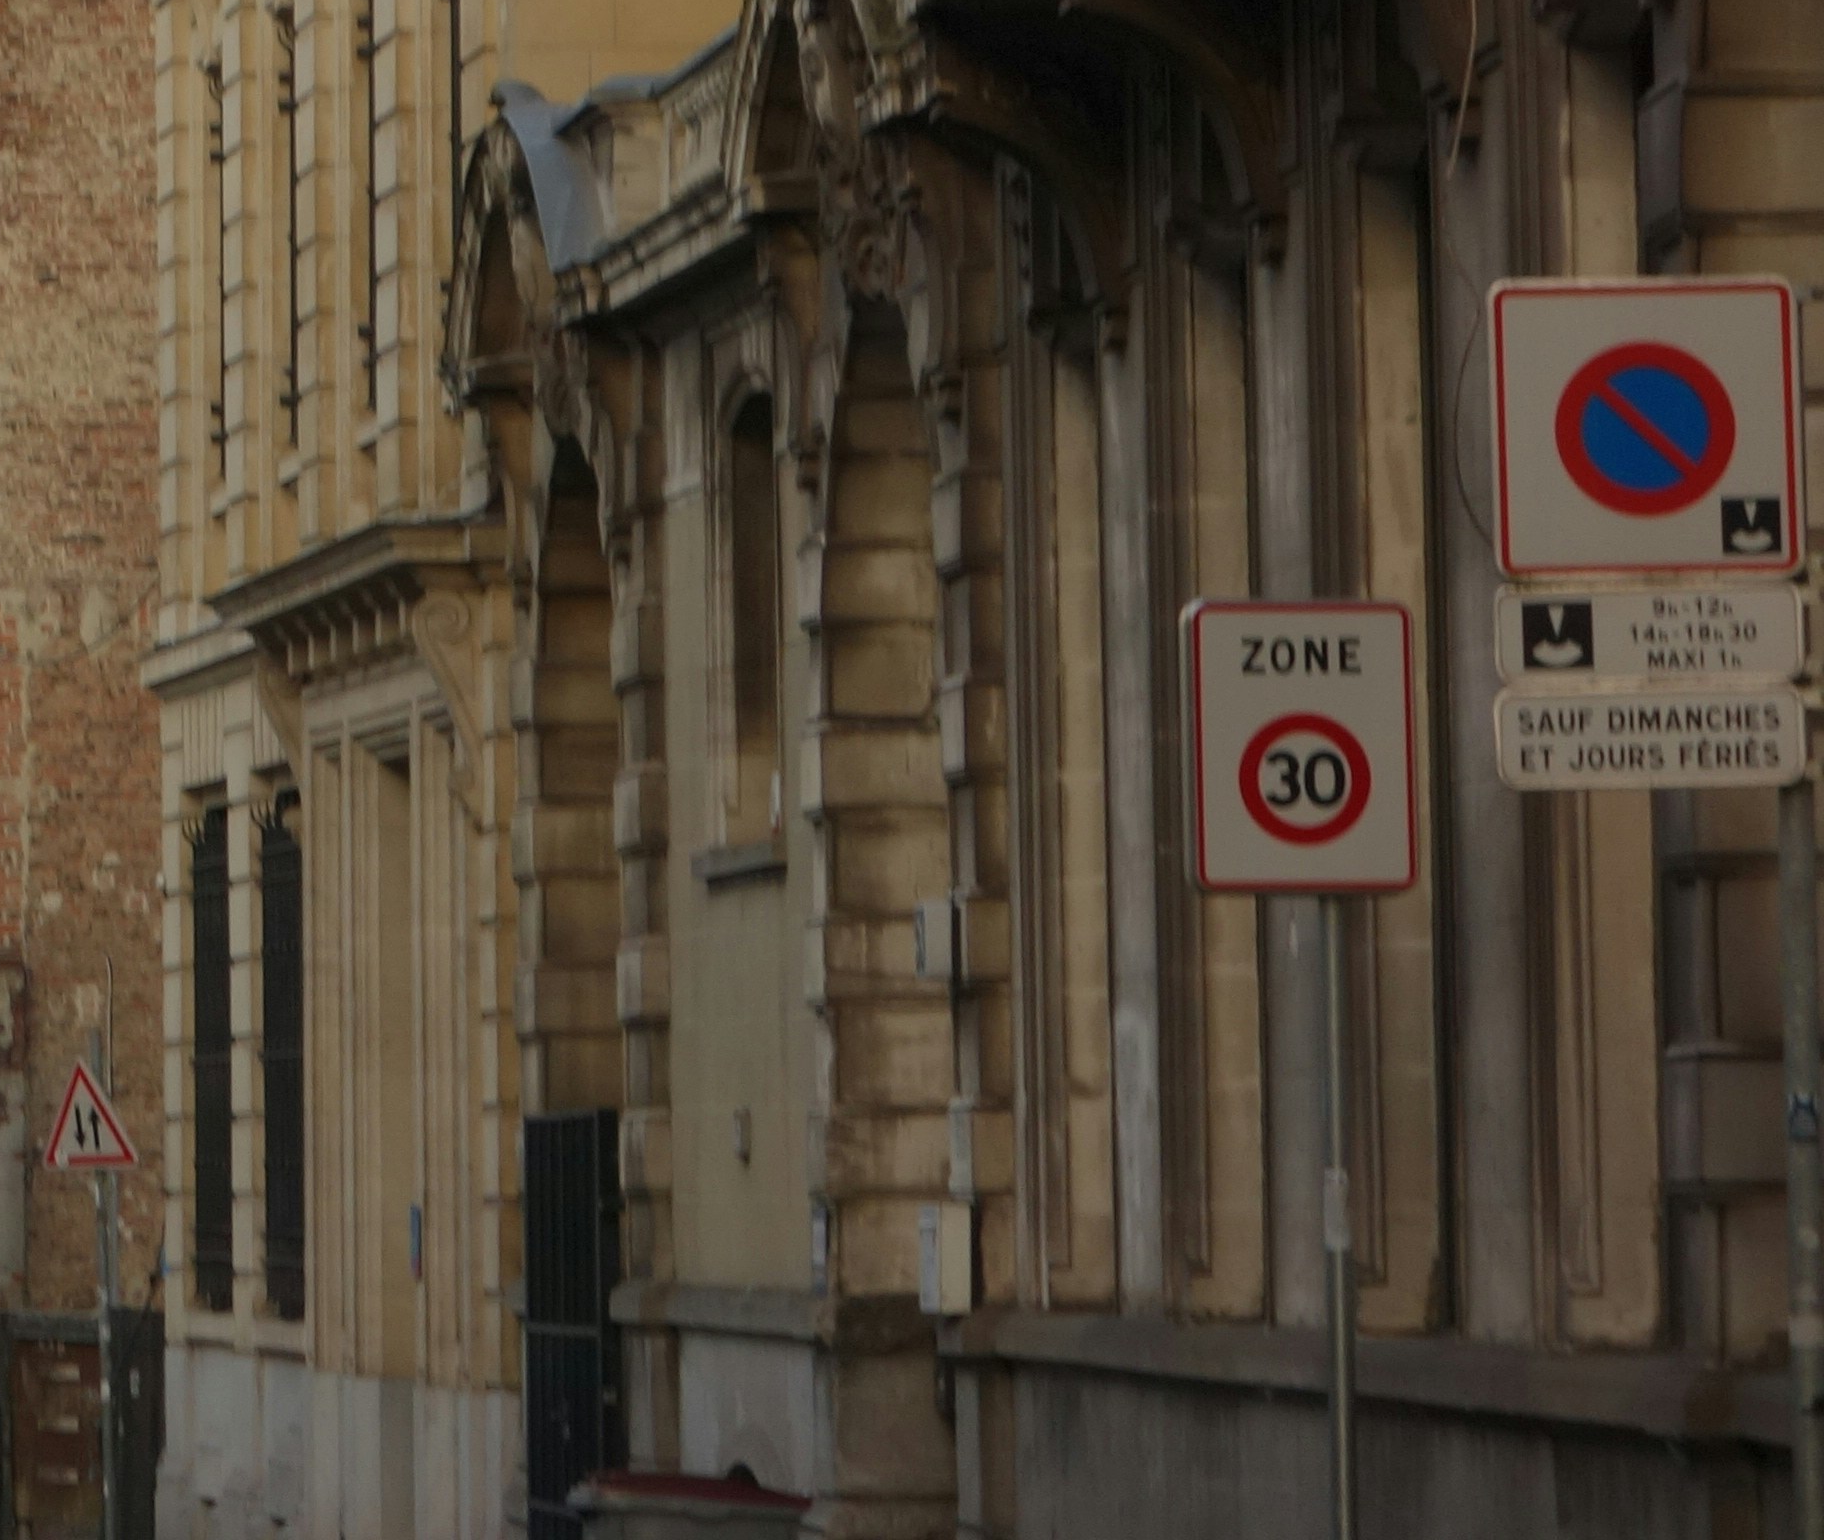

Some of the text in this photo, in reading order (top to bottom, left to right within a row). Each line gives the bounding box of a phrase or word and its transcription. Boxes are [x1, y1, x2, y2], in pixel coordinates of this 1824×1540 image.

[1242, 636, 1361, 675] ZONE
[1647, 647, 1742, 669] MAXI 1h
[1518, 701, 1781, 735] SAUF DIMANCHES
[1520, 735, 1781, 773] ET JOURS FÉRIÉS
[1266, 749, 1345, 807] 30
